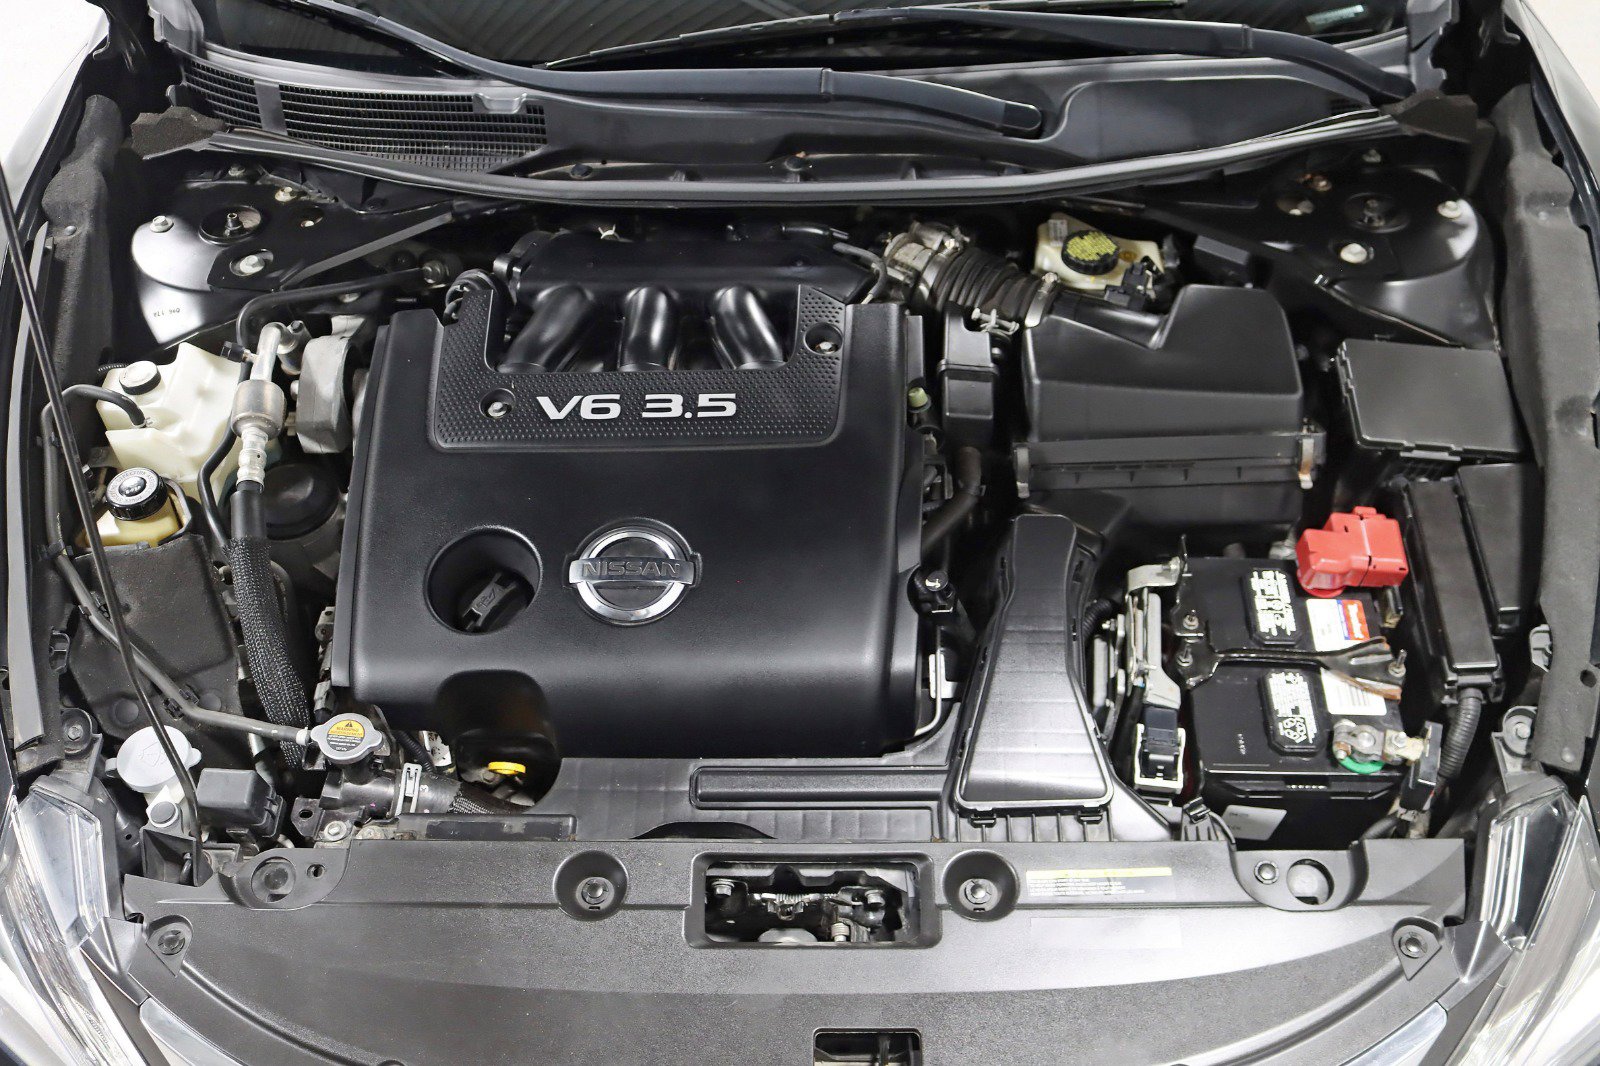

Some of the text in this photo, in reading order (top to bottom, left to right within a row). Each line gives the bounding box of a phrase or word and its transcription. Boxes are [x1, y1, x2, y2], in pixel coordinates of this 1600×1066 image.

[536, 393, 737, 420] V6 3.5
[582, 560, 681, 578] NISSAN
